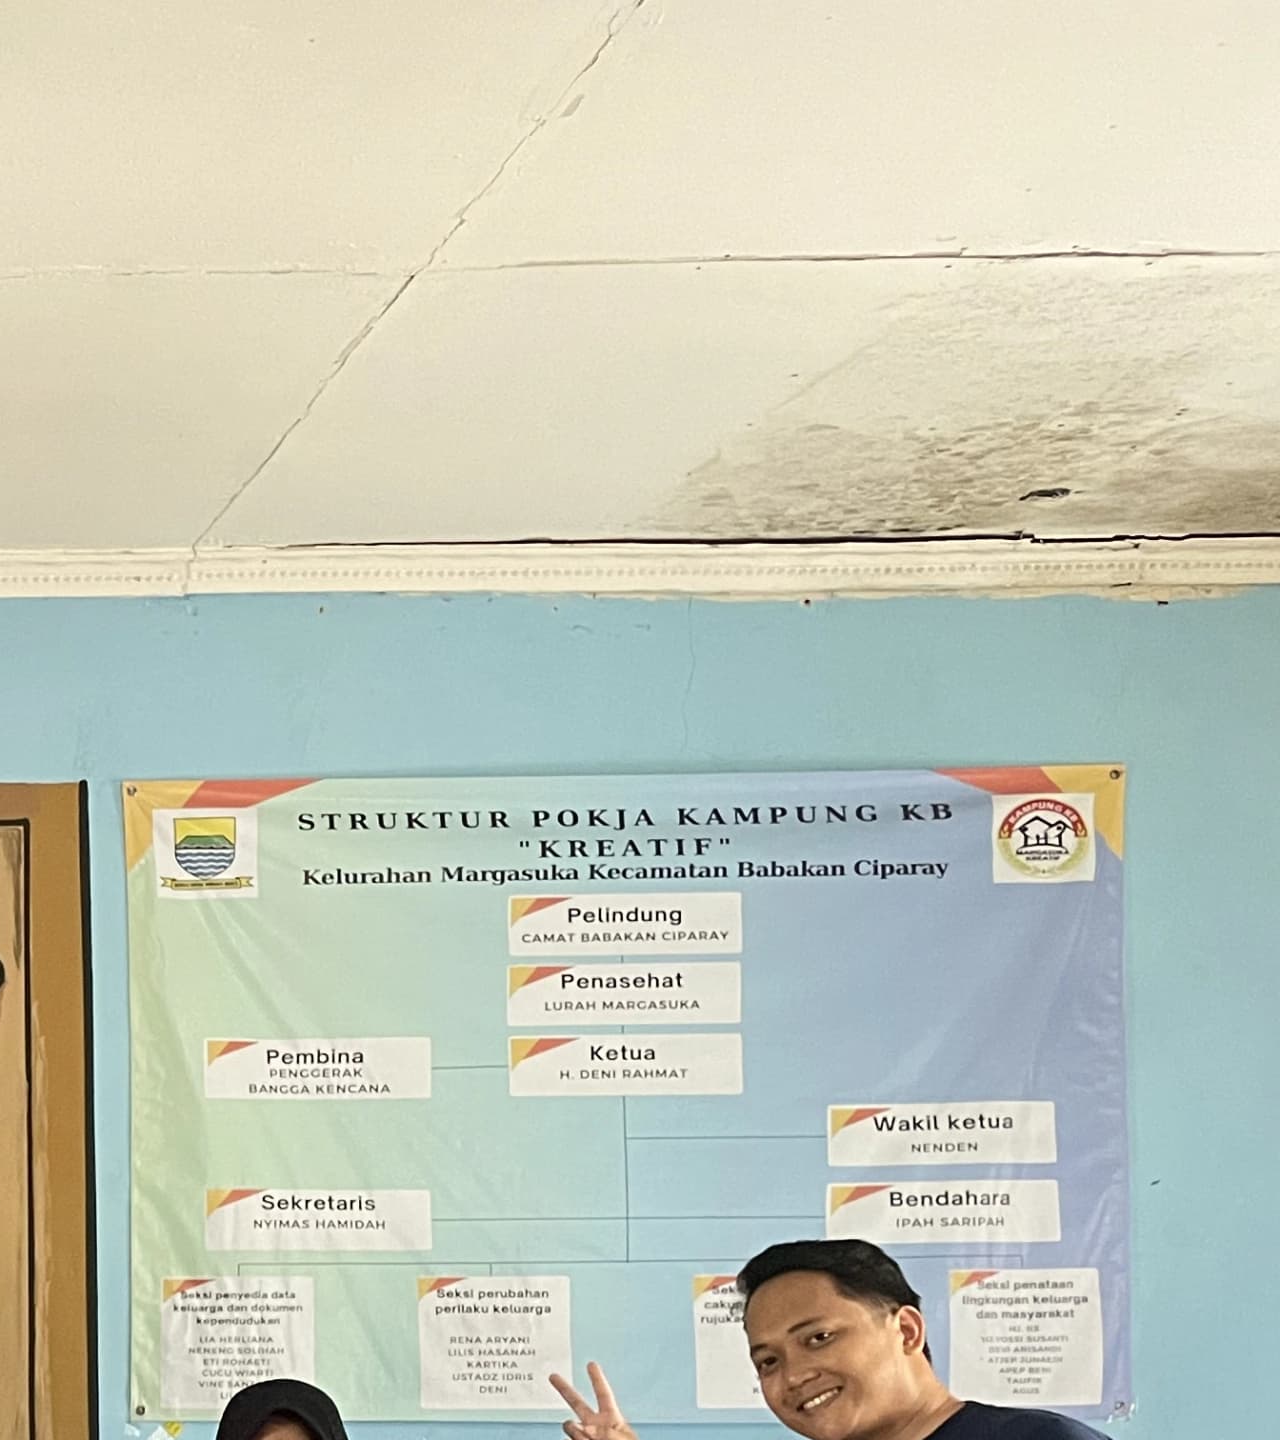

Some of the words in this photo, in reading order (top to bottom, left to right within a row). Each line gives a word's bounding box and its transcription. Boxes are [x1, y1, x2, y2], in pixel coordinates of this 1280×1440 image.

[298, 810, 510, 831] STRUKTUR
[532, 808, 656, 831] POKJA
[677, 804, 877, 826] KAMPUNG
[900, 803, 953, 821] KB
[519, 837, 730, 859] "KREATIF"
[303, 867, 432, 885] Kelurahan
[441, 865, 579, 888] Margasuka
[588, 862, 730, 881] Kecamatan
[737, 860, 846, 878] Babakan
[853, 859, 948, 880] Ciparay
[567, 906, 682, 926] Pelindung
[521, 932, 575, 944] CAMAT
[580, 931, 657, 943] BABAKAN
[661, 930, 729, 941] CIPARAY
[560, 972, 684, 991] Penasehat
[544, 1000, 596, 1012] LURAH
[602, 999, 700, 1011] MARGASUKA
[266, 1048, 364, 1065] Pembina
[590, 1045, 656, 1061] Ketua
[269, 1067, 363, 1079] PENGGERAK
[579, 1069, 616, 1080] DENI
[621, 1068, 687, 1079] RAHMAT
[248, 1083, 310, 1095] BANGGA
[315, 1083, 391, 1095] KENCANA
[873, 1113, 940, 1132] Wakil
[947, 1113, 1013, 1130] ketua
[911, 1142, 978, 1153] NENDEN
[261, 1194, 376, 1211] Sekretaris
[889, 1189, 1011, 1208] Bendahara
[253, 1219, 310, 1229] NYIMAS
[315, 1219, 386, 1230] HAMIDAH
[895, 1217, 934, 1228] IPAH
[939, 1216, 1005, 1228] SARIPAH
[436, 1288, 472, 1300] Seksi
[477, 1288, 550, 1301] perubahan
[1032, 1294, 1089, 1306] keluarga
[173, 1303, 224, 1314] keluarga
[226, 1303, 248, 1312] dan
[251, 1303, 304, 1312] dokumen
[435, 1303, 489, 1316] perilaku
[492, 1304, 552, 1316] keluarga
[466, 1360, 518, 1369] KARTIKA
